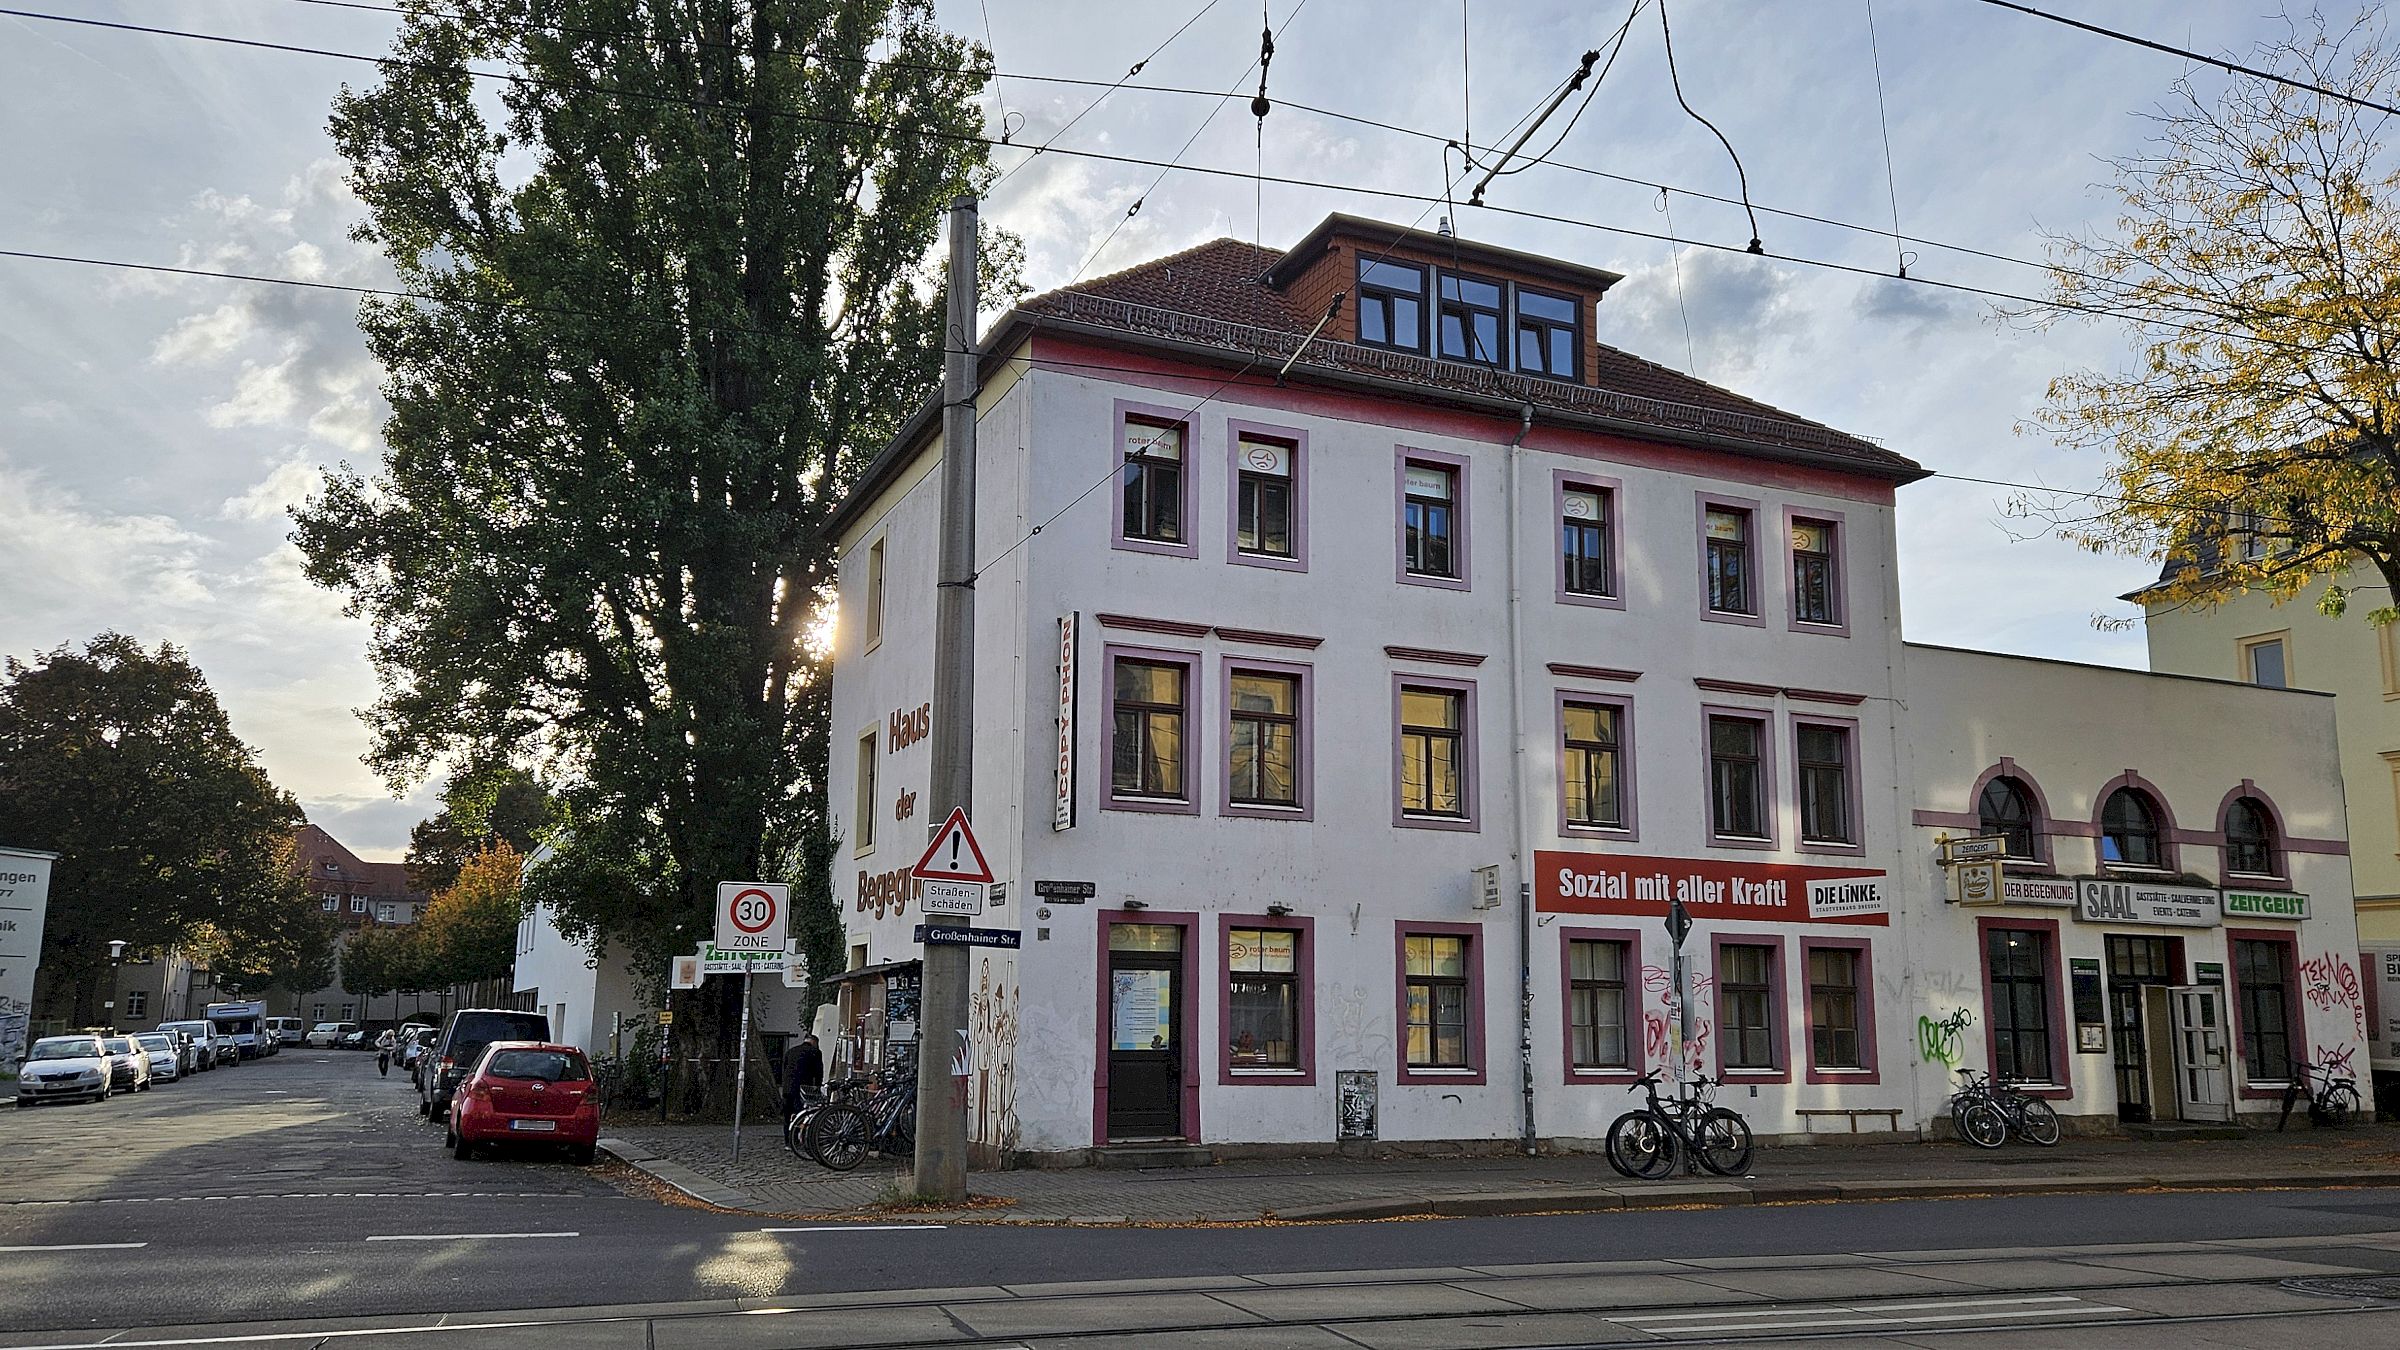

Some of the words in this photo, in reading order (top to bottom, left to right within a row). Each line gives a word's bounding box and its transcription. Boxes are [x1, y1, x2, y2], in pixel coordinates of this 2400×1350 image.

[888, 702, 931, 755] Haus
[895, 787, 917, 822] der
[930, 885, 976, 898] Straßen-
[1559, 867, 1628, 900] Sozial
[1634, 872, 1671, 902] mit
[1676, 874, 1726, 904] aller
[1731, 876, 1788, 907] Kraft!
[1814, 886, 1836, 905] DIE
[2004, 882, 2022, 898] DER
[2023, 883, 2074, 901] BEGEGNUNG
[930, 899, 973, 911] schäden
[2086, 883, 2139, 920] SAAL
[2136, 891, 2168, 903] GASTSTÄTTE
[2228, 894, 2305, 915] ZEITGEIST
[739, 900, 767, 922] 30
[1815, 905, 1857, 913] STADTVERBAND
[2152, 906, 2173, 917] EVENTS
[2176, 908, 2201, 918] CATERING
[733, 935, 769, 948] ZONE
[930, 929, 999, 944] Großenhainer
[1001, 934, 1017, 946] Str.
